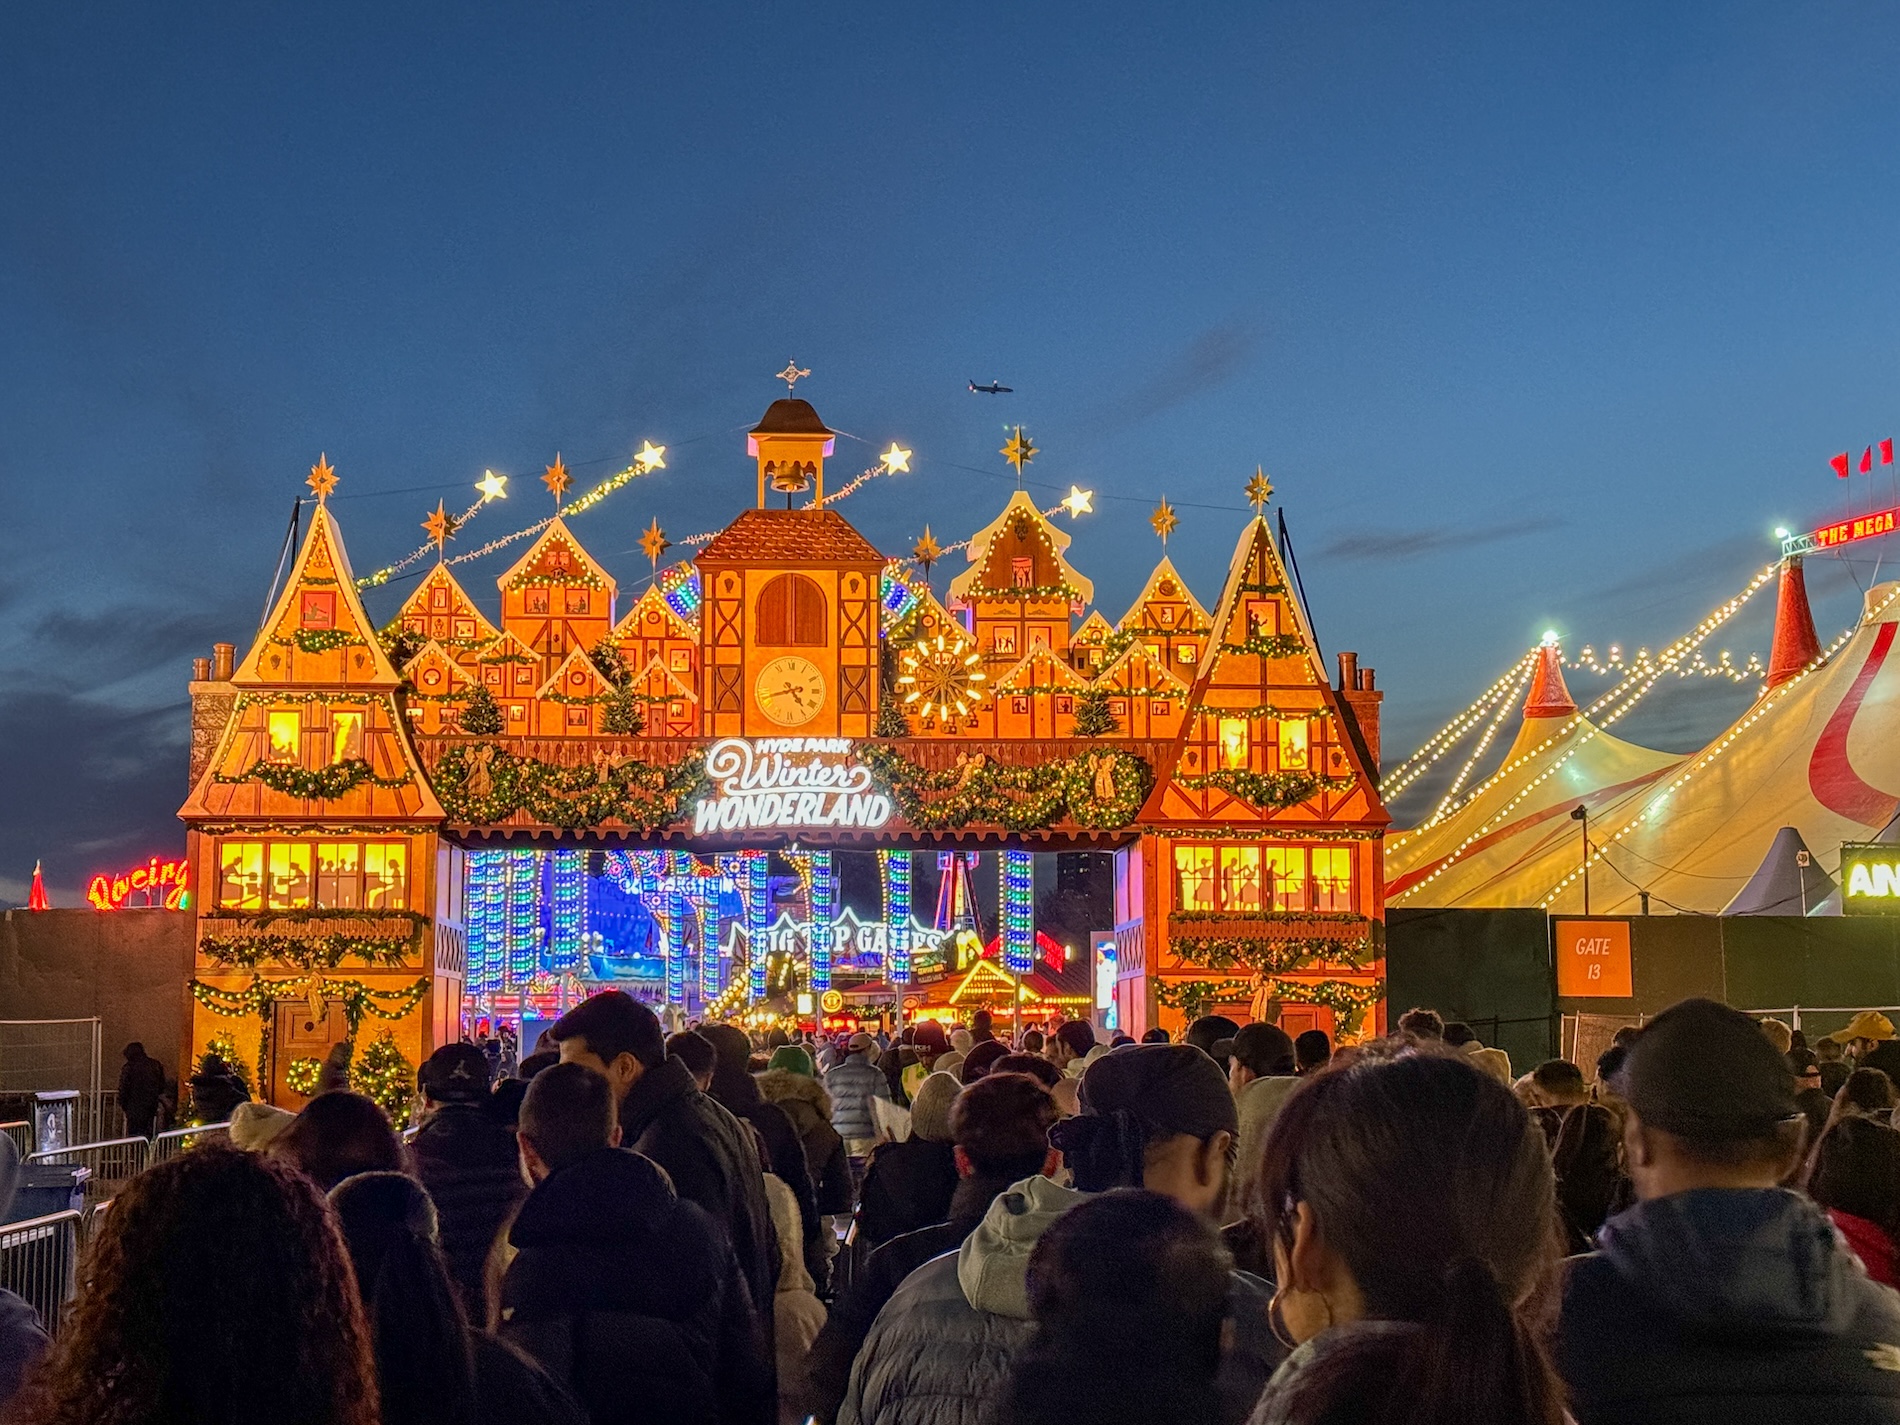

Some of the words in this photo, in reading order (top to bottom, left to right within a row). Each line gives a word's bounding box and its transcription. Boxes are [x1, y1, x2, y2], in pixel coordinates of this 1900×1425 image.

[1818, 524, 1849, 547] THE
[1853, 512, 1895, 539] MEGA
[755, 738, 802, 754] HYDE
[804, 738, 852, 754] PARK
[706, 739, 872, 796] Winter
[694, 793, 891, 835] WONDERLAND
[1575, 937, 1611, 956] GATE
[1586, 963, 1602, 981] 13
